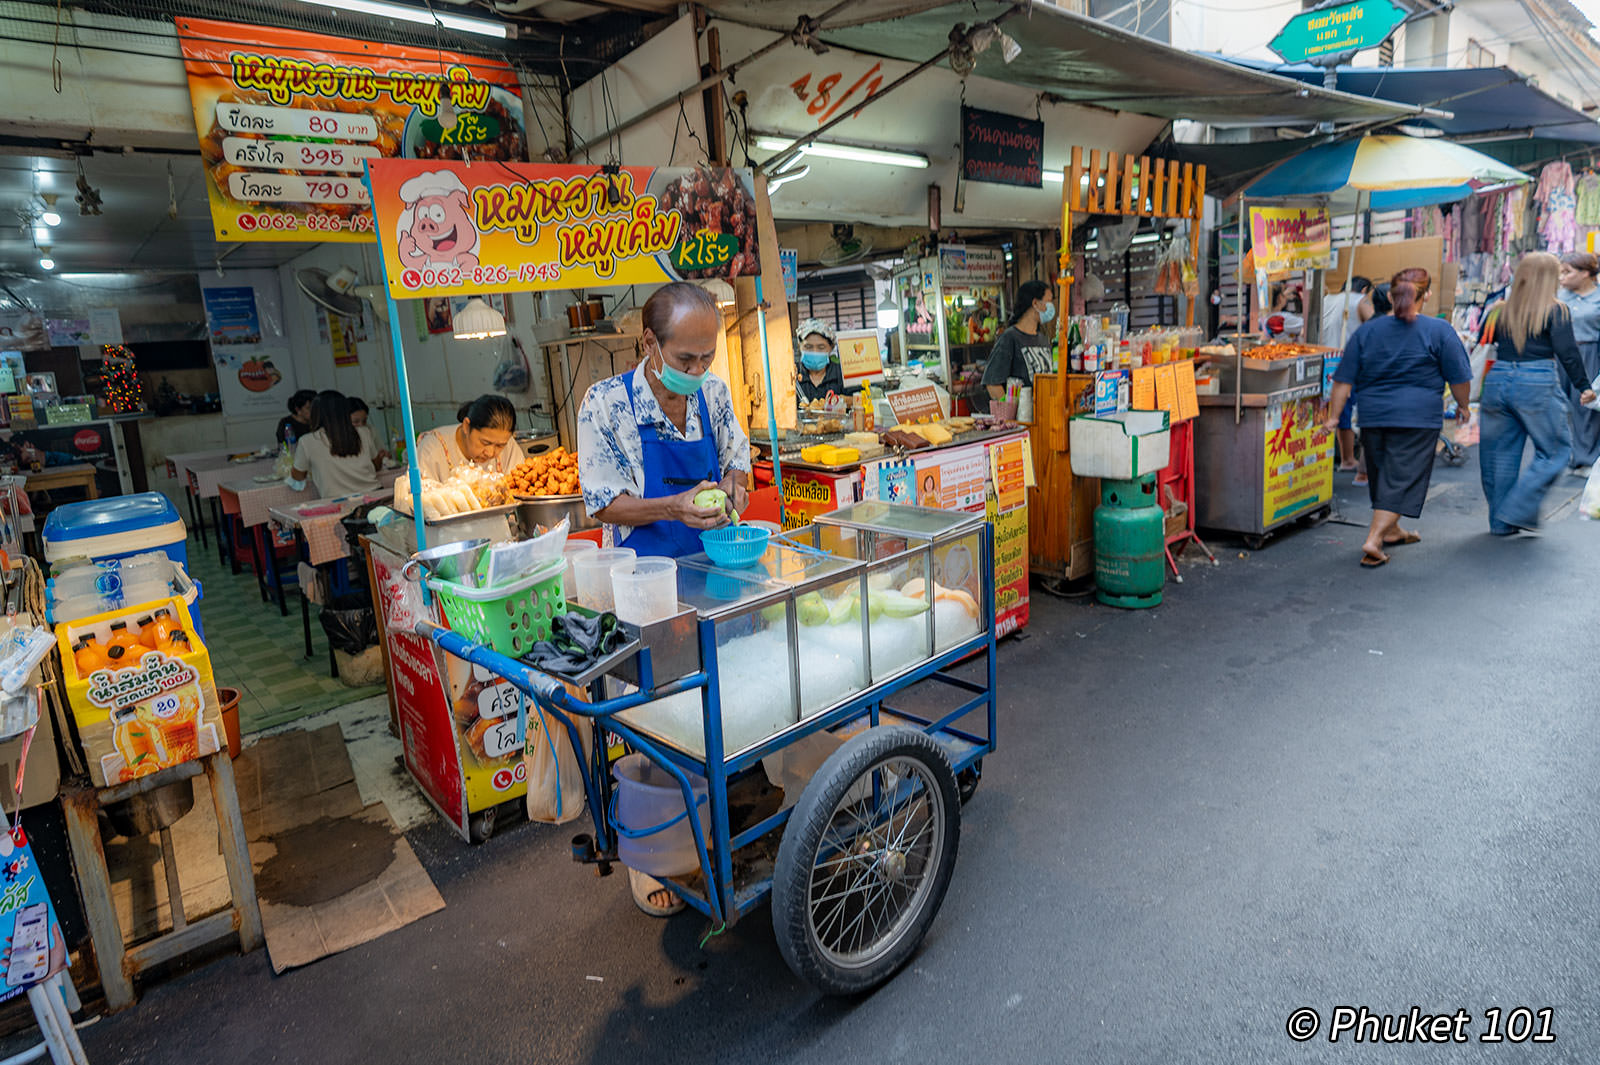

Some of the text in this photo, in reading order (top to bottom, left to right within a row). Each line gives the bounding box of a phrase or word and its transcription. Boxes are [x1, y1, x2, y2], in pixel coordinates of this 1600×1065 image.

[228, 109, 368, 135] ขีดละ 80 บาท
[235, 141, 284, 164] ครึ่งโล
[301, 147, 344, 166] 395
[241, 177, 282, 196] โลละ
[305, 182, 349, 199] 790
[474, 173, 634, 241] หมูหวาน
[561, 198, 680, 274] หมูเค็ม
[422, 263, 560, 286] 062-826-1945
[95, 656, 178, 700] น้ำส้มคั้น
[117, 672, 190, 705] สดแท้ 100%
[157, 698, 175, 713] 20
[0, 876, 35, 915] ลัส
